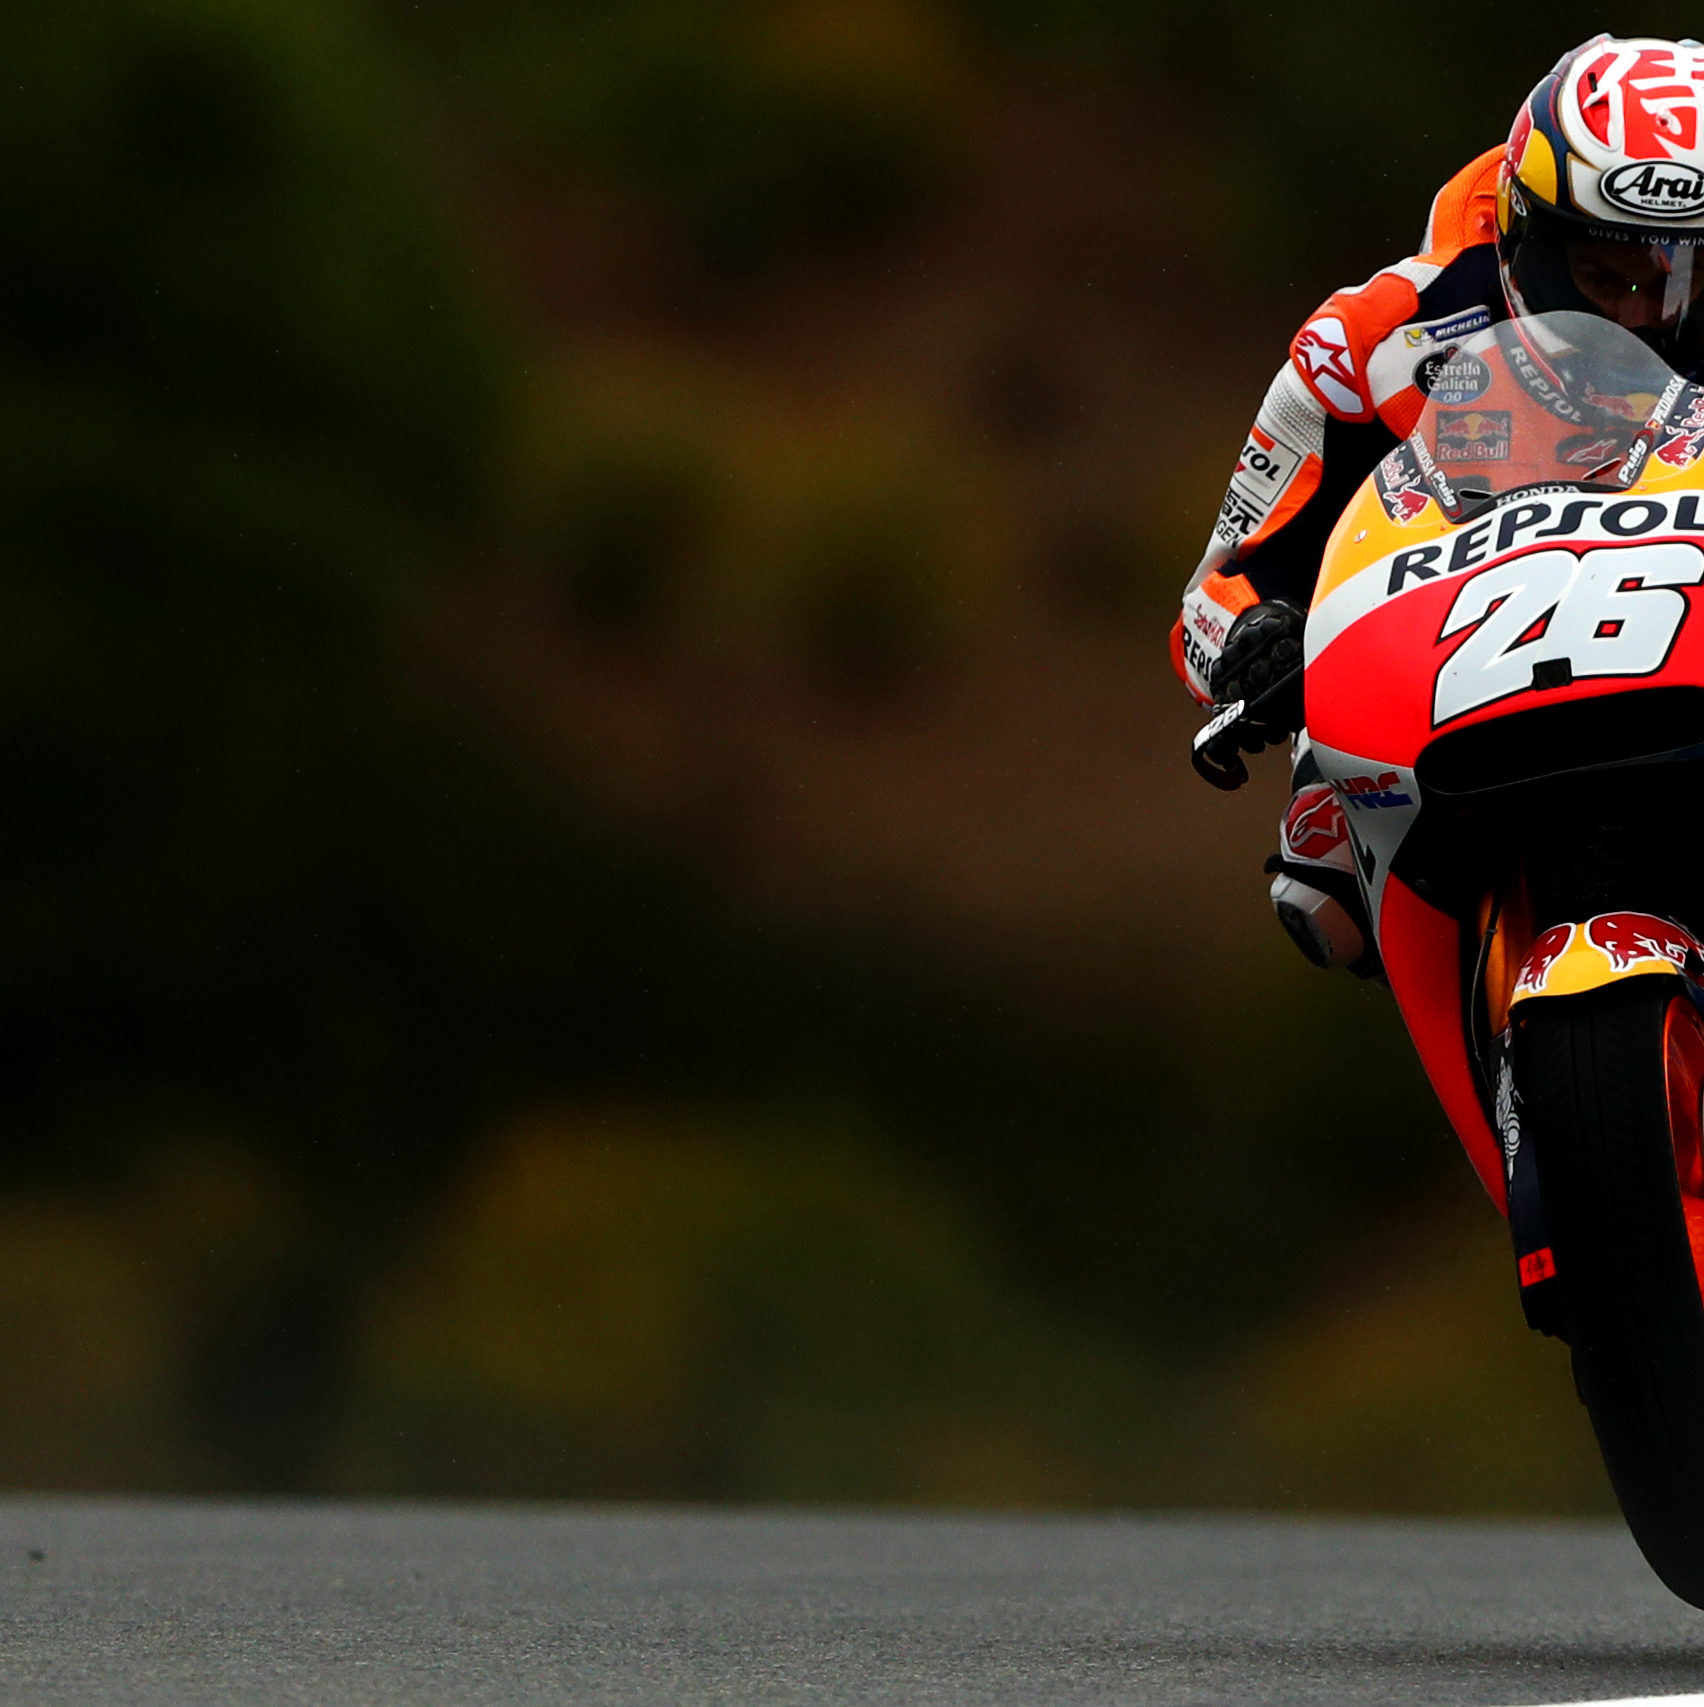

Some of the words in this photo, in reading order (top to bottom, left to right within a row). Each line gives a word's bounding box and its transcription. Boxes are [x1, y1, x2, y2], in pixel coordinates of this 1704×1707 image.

[1589, 226, 1630, 241] GIVES
[1640, 234, 1670, 246] YOU
[1435, 314, 1490, 338] MICHELIN
[1424, 361, 1481, 376] Estrella
[1427, 375, 1479, 391] Galicia
[1438, 441, 1472, 460] Red
[1472, 440, 1509, 459] Bull
[1617, 438, 1647, 484] Puig
[1431, 470, 1457, 507] Puig
[1497, 485, 1580, 508] HONDA
